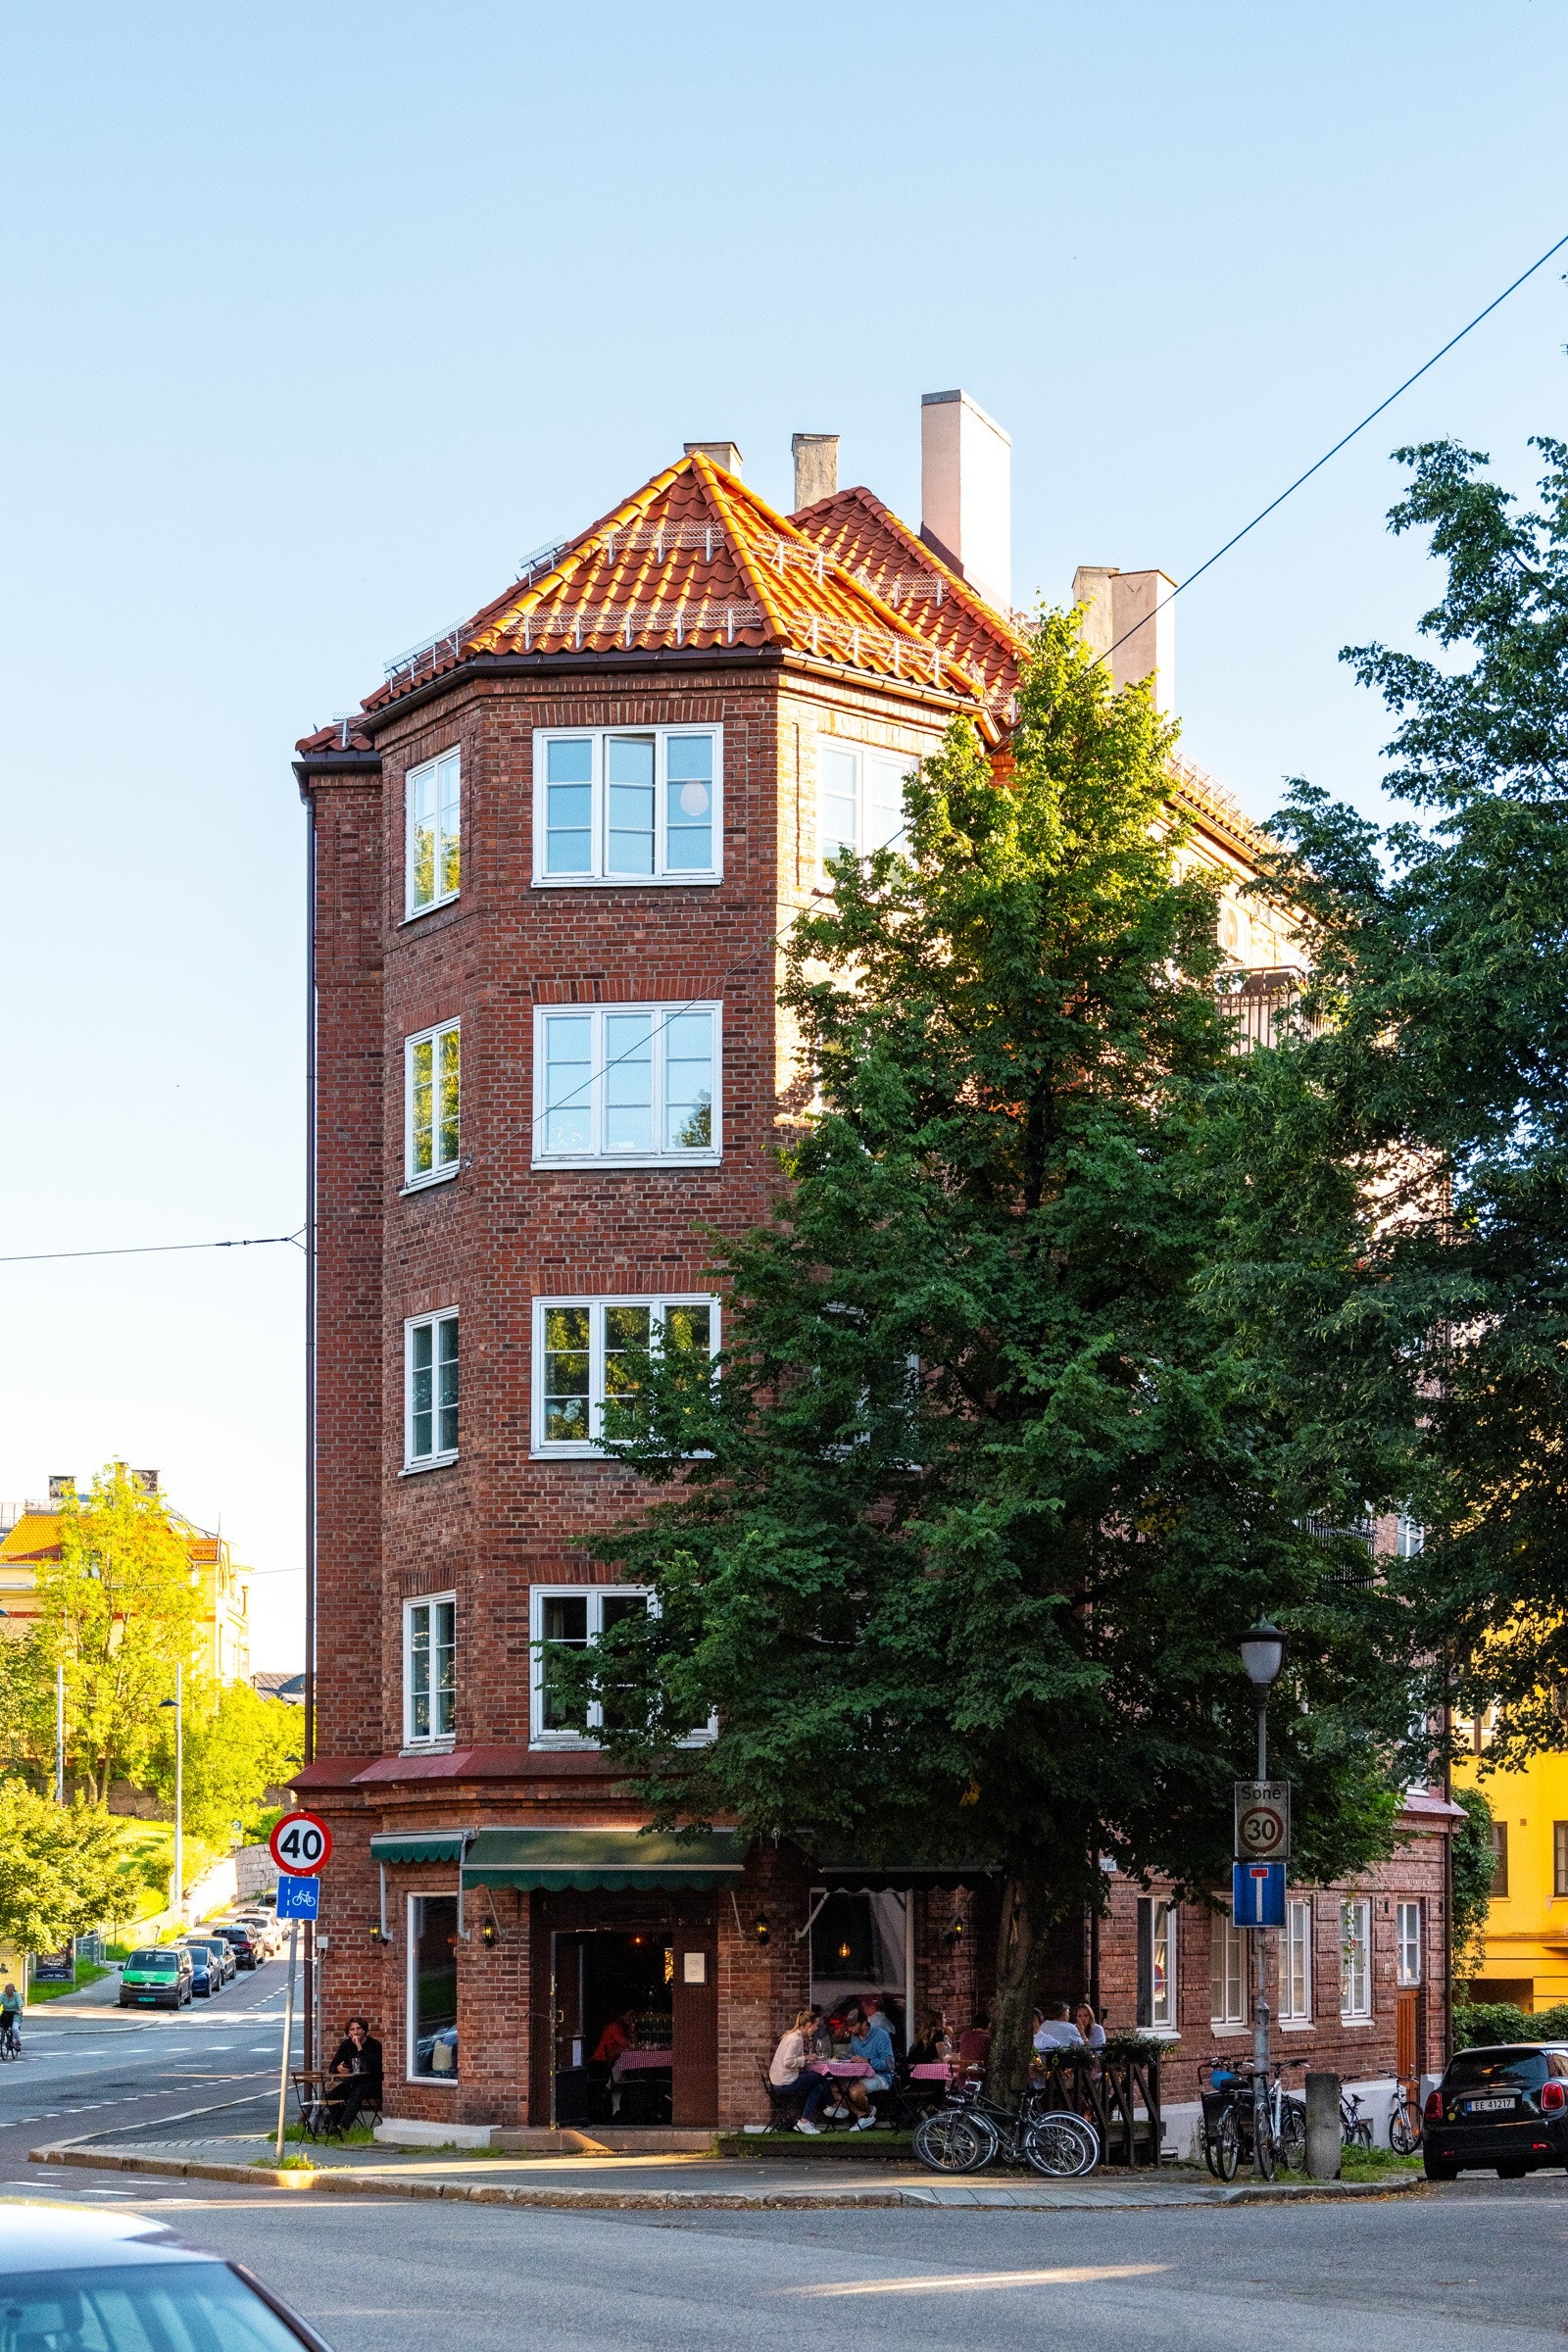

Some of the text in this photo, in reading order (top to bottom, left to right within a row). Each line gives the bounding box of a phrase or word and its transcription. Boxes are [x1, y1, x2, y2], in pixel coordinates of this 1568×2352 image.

[1242, 1786, 1282, 1800] Sone
[1247, 1819, 1276, 1841] 30
[280, 1829, 322, 1860] 40
[1488, 2099, 1511, 2109] 41217
